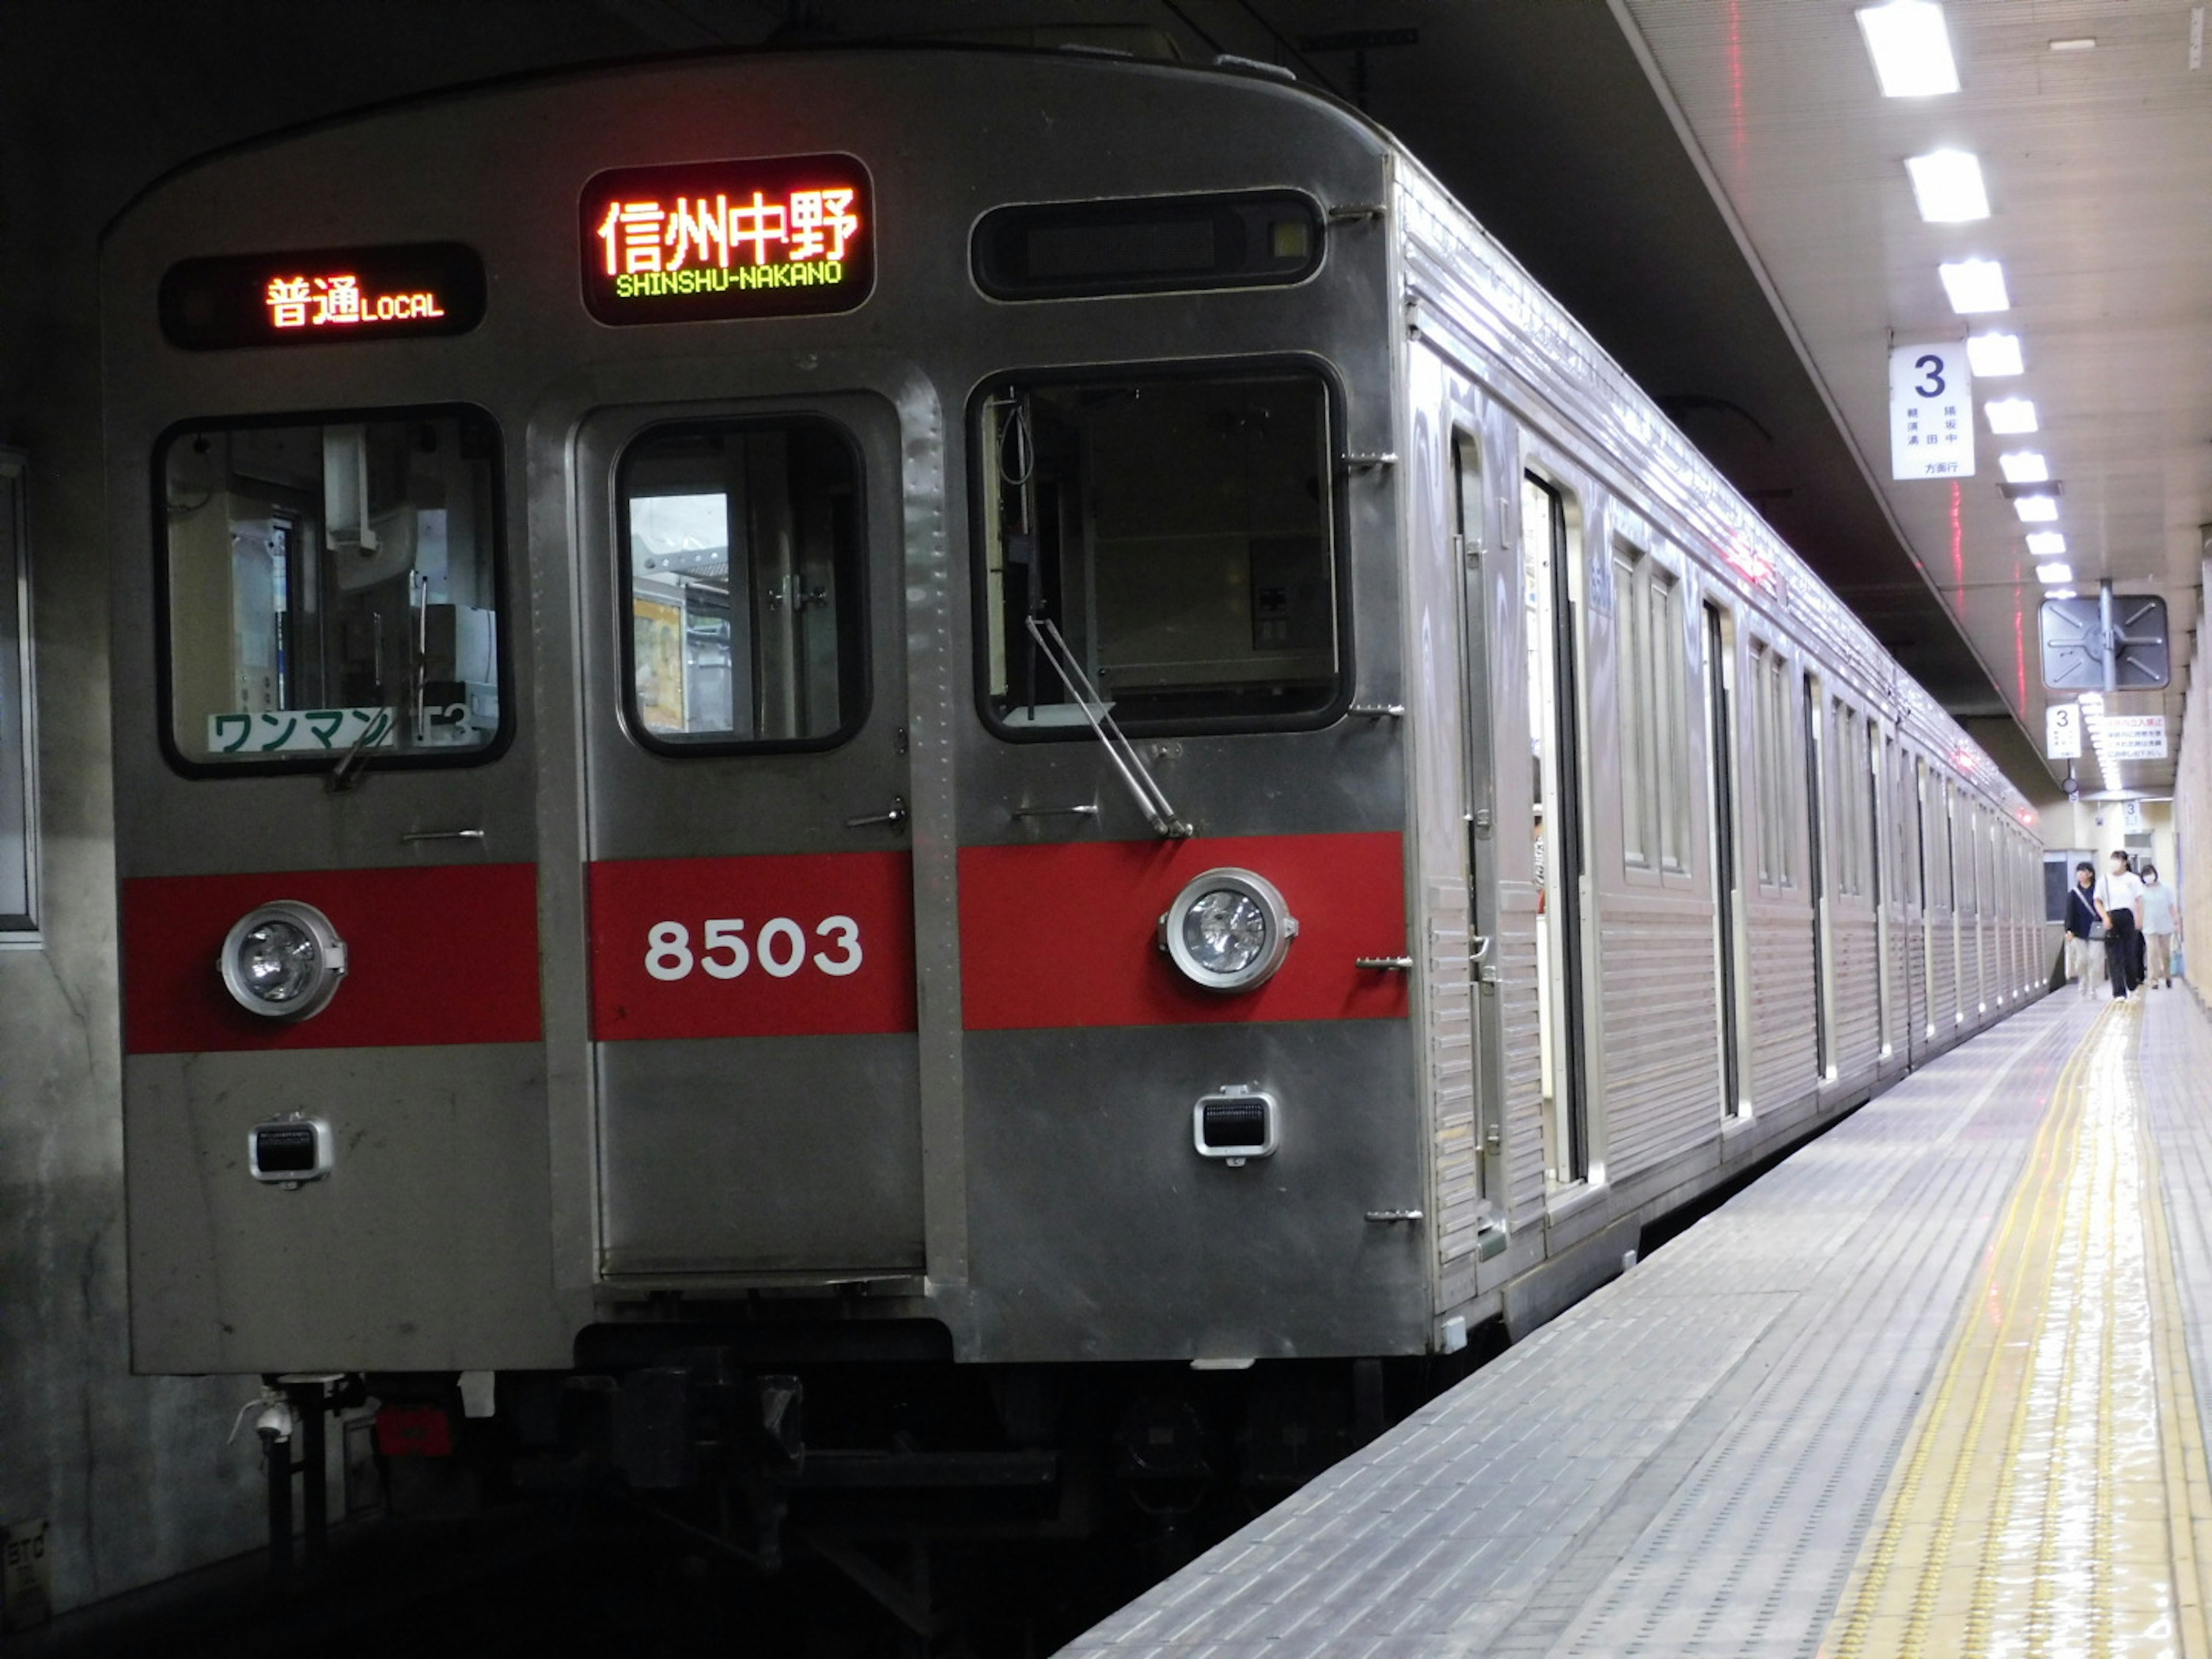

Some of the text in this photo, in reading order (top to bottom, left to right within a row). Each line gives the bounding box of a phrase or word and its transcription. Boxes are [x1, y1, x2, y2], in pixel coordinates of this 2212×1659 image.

[597, 187, 858, 276] 信州中野
[616, 260, 842, 298] SHINSHU-NAKANO
[266, 275, 445, 328] 普通 LOCAL
[1915, 354, 1946, 398] 3
[215, 710, 388, 753] ワンマン
[2056, 710, 2069, 727] 3
[2127, 802, 2135, 815] 3
[644, 914, 863, 981] 8503
